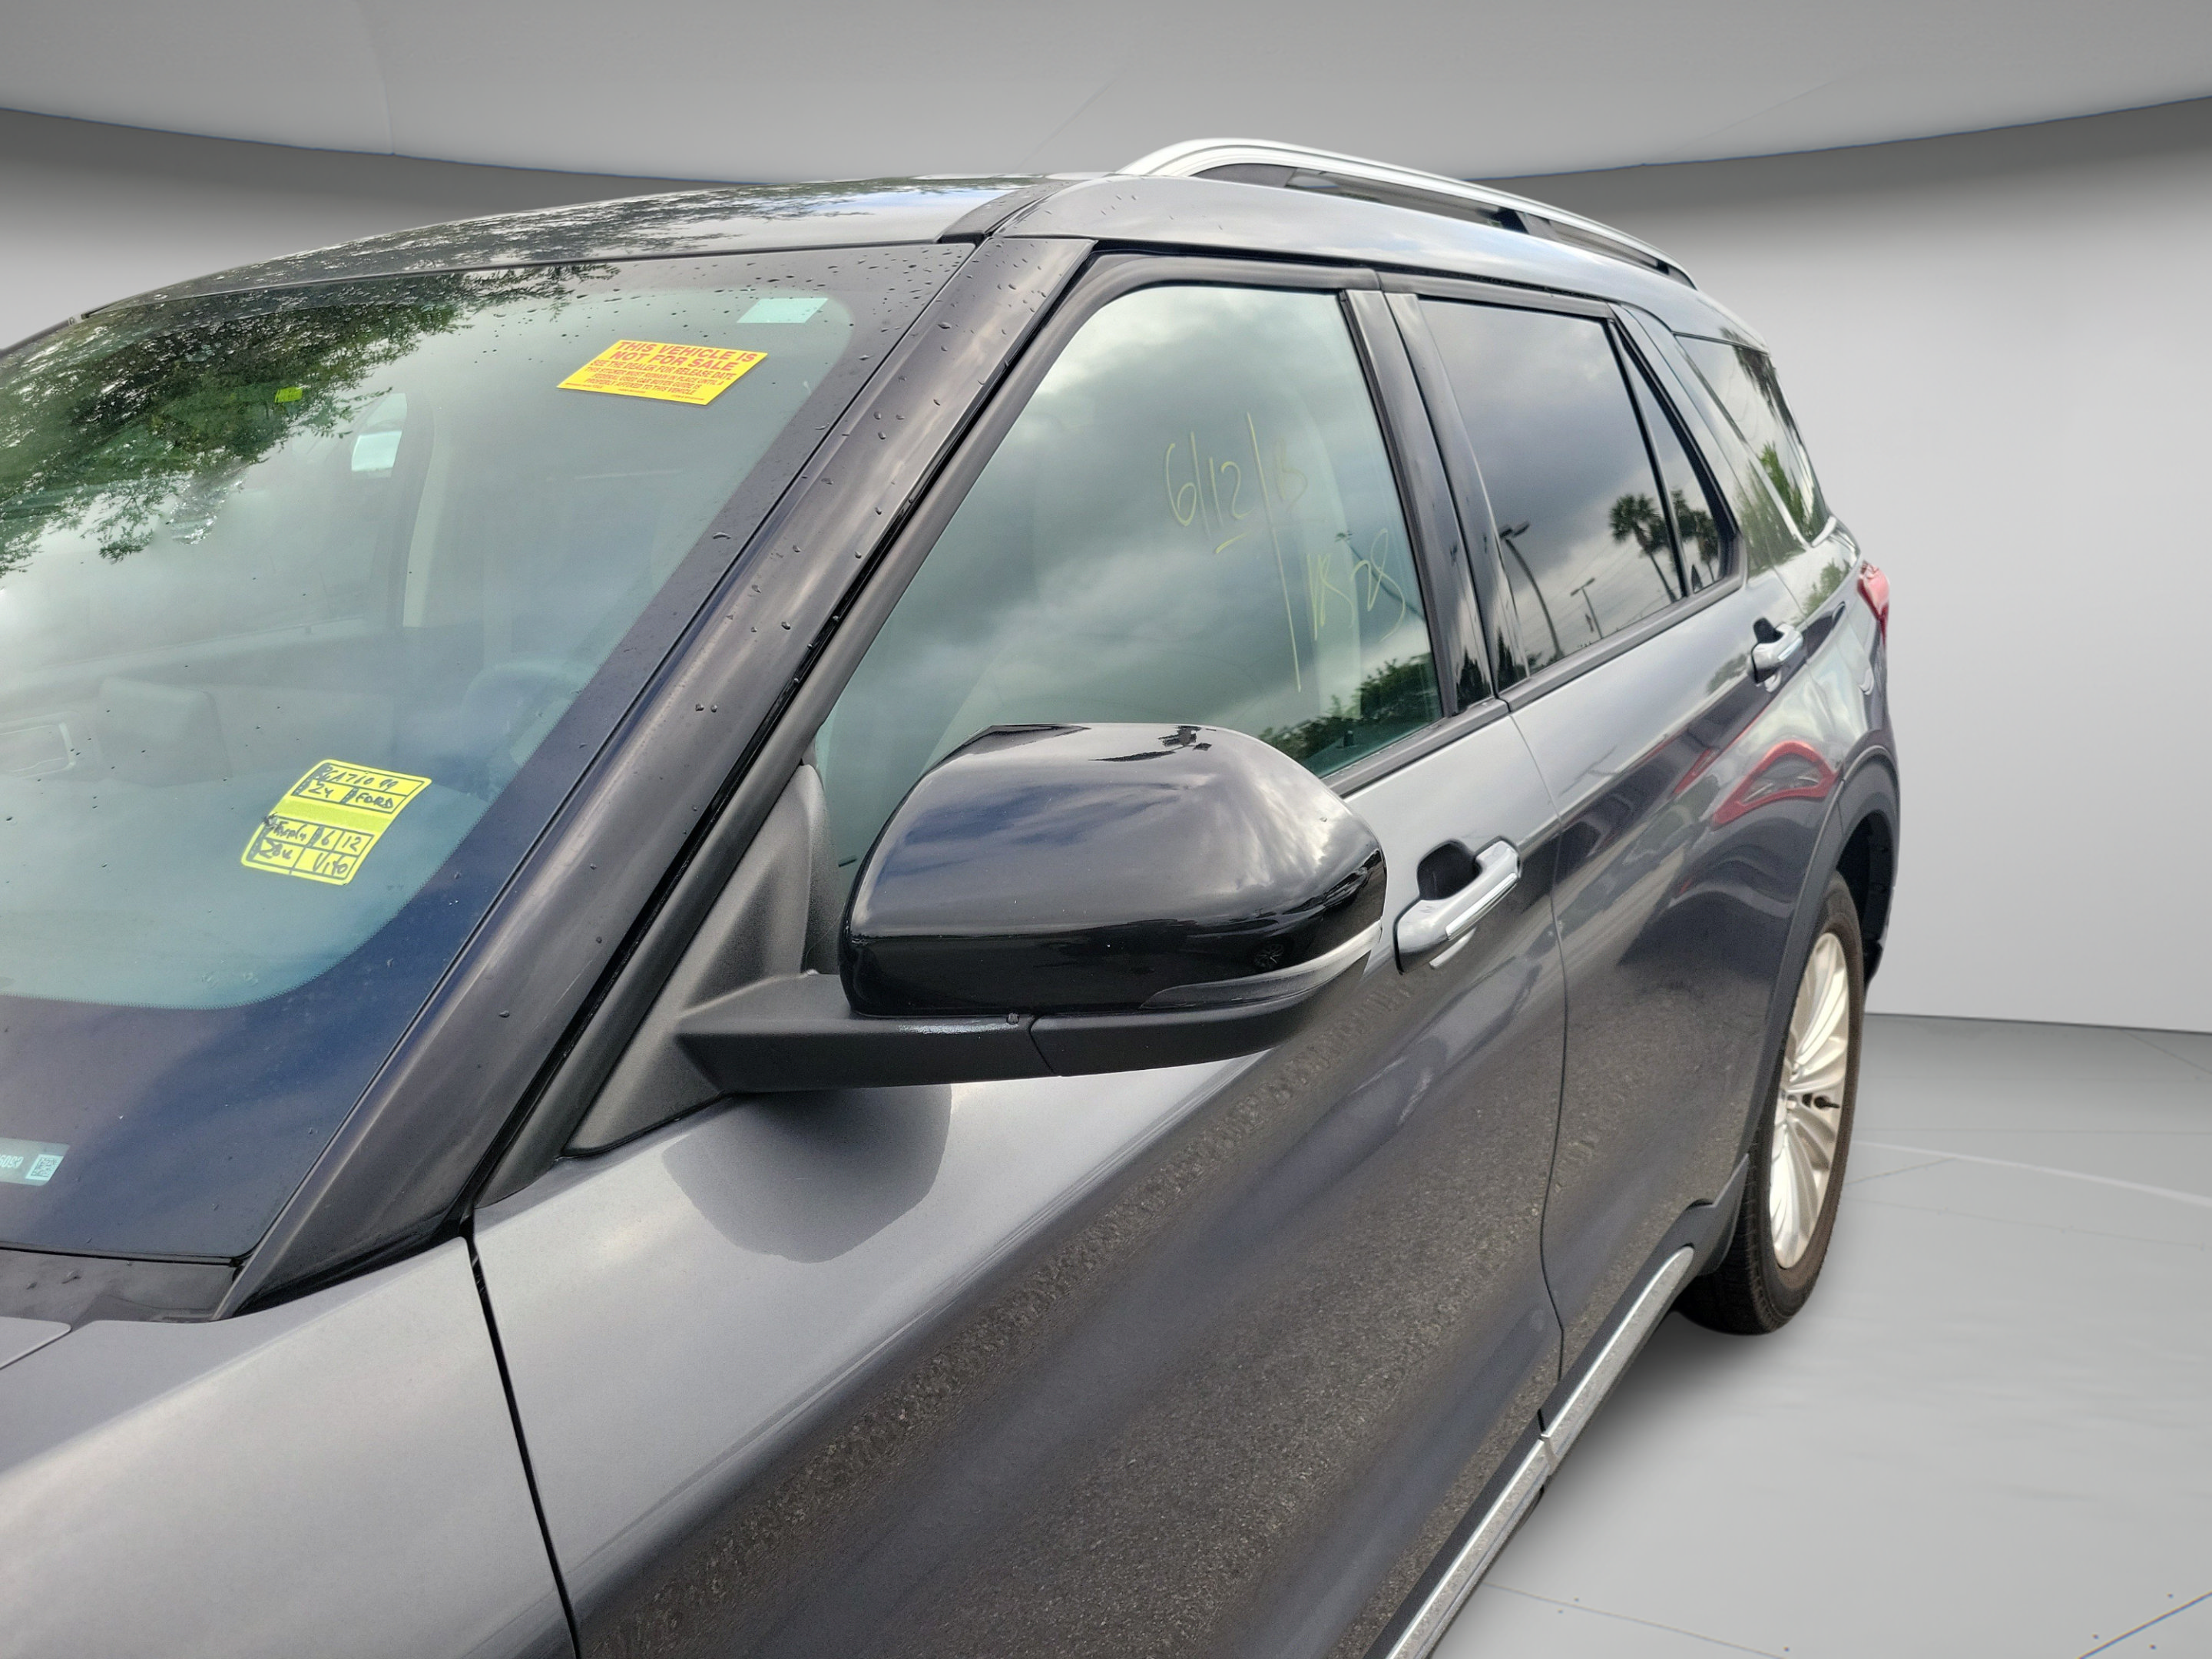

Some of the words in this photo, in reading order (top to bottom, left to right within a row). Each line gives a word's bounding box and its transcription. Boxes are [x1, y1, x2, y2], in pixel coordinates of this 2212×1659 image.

[616, 342, 657, 353] THIS
[658, 345, 737, 359] VEHICLE
[736, 353, 758, 362] IS
[609, 351, 651, 362] NOT
[648, 355, 687, 366] FOR
[688, 358, 739, 371] SALE
[624, 363, 657, 371] DEALER
[655, 365, 675, 373] FOR
[674, 366, 714, 378] RELEASE
[711, 371, 737, 380] DATE
[667, 387, 697, 396] VEHICLE
[356, 791, 393, 809] FORD
[343, 835, 362, 852] 12
